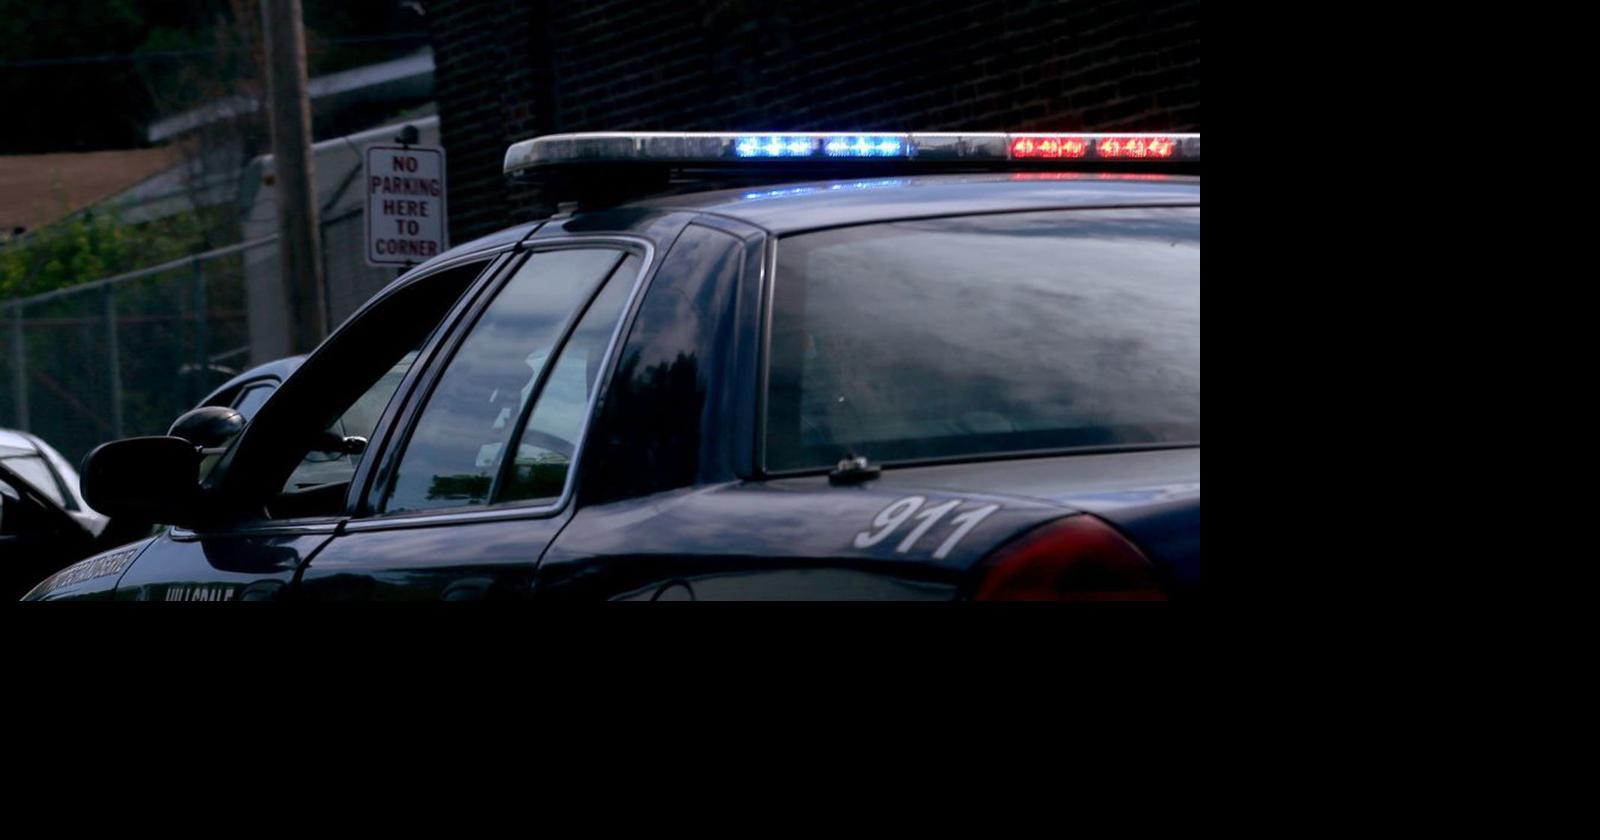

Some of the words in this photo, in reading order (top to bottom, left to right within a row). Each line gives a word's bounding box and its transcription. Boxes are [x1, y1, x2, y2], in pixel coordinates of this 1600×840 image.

[393, 156, 418, 172] NO
[371, 176, 441, 196] PARKING
[383, 199, 429, 217] HERE
[396, 219, 420, 236] TO
[375, 238, 438, 256] CORNER
[853, 495, 999, 560] 911
